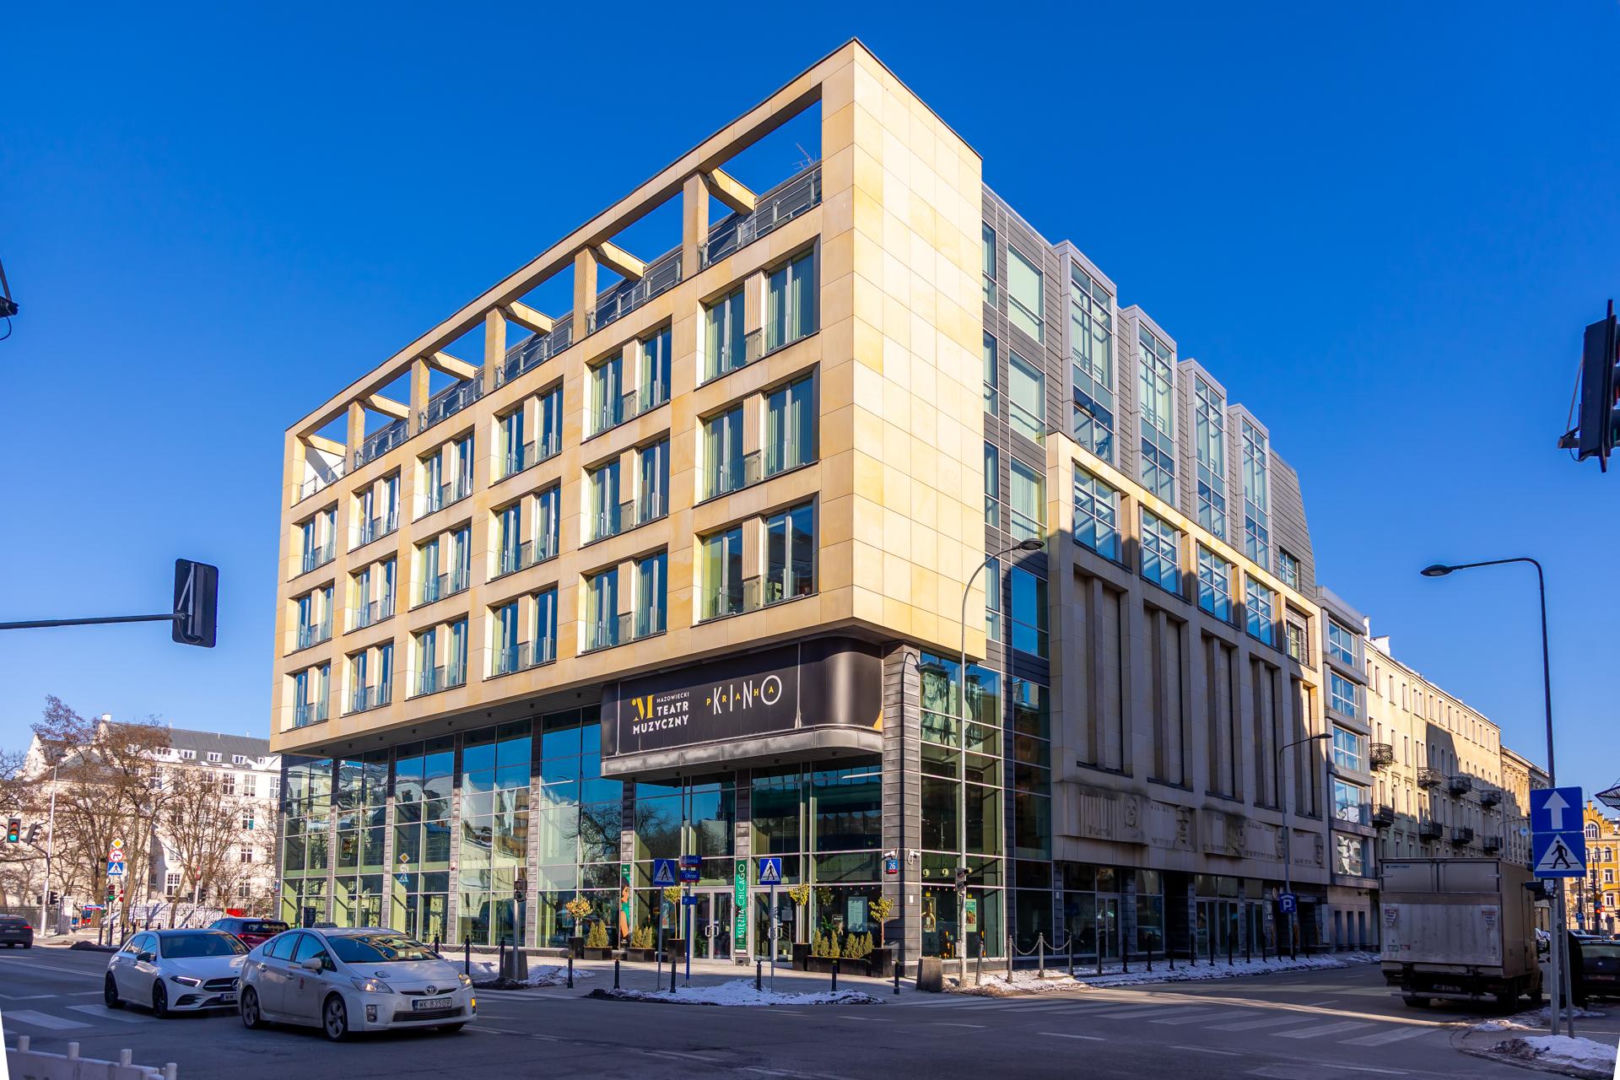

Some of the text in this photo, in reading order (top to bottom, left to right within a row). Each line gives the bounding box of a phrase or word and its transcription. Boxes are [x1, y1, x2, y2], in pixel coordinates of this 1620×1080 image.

[656, 691, 690, 703] MAZOWIECKI
[713, 675, 783, 715] KINO
[656, 701, 689, 717] TEATR
[632, 714, 689, 735] MUZYCZNY
[738, 863, 746, 906] CHICAGO
